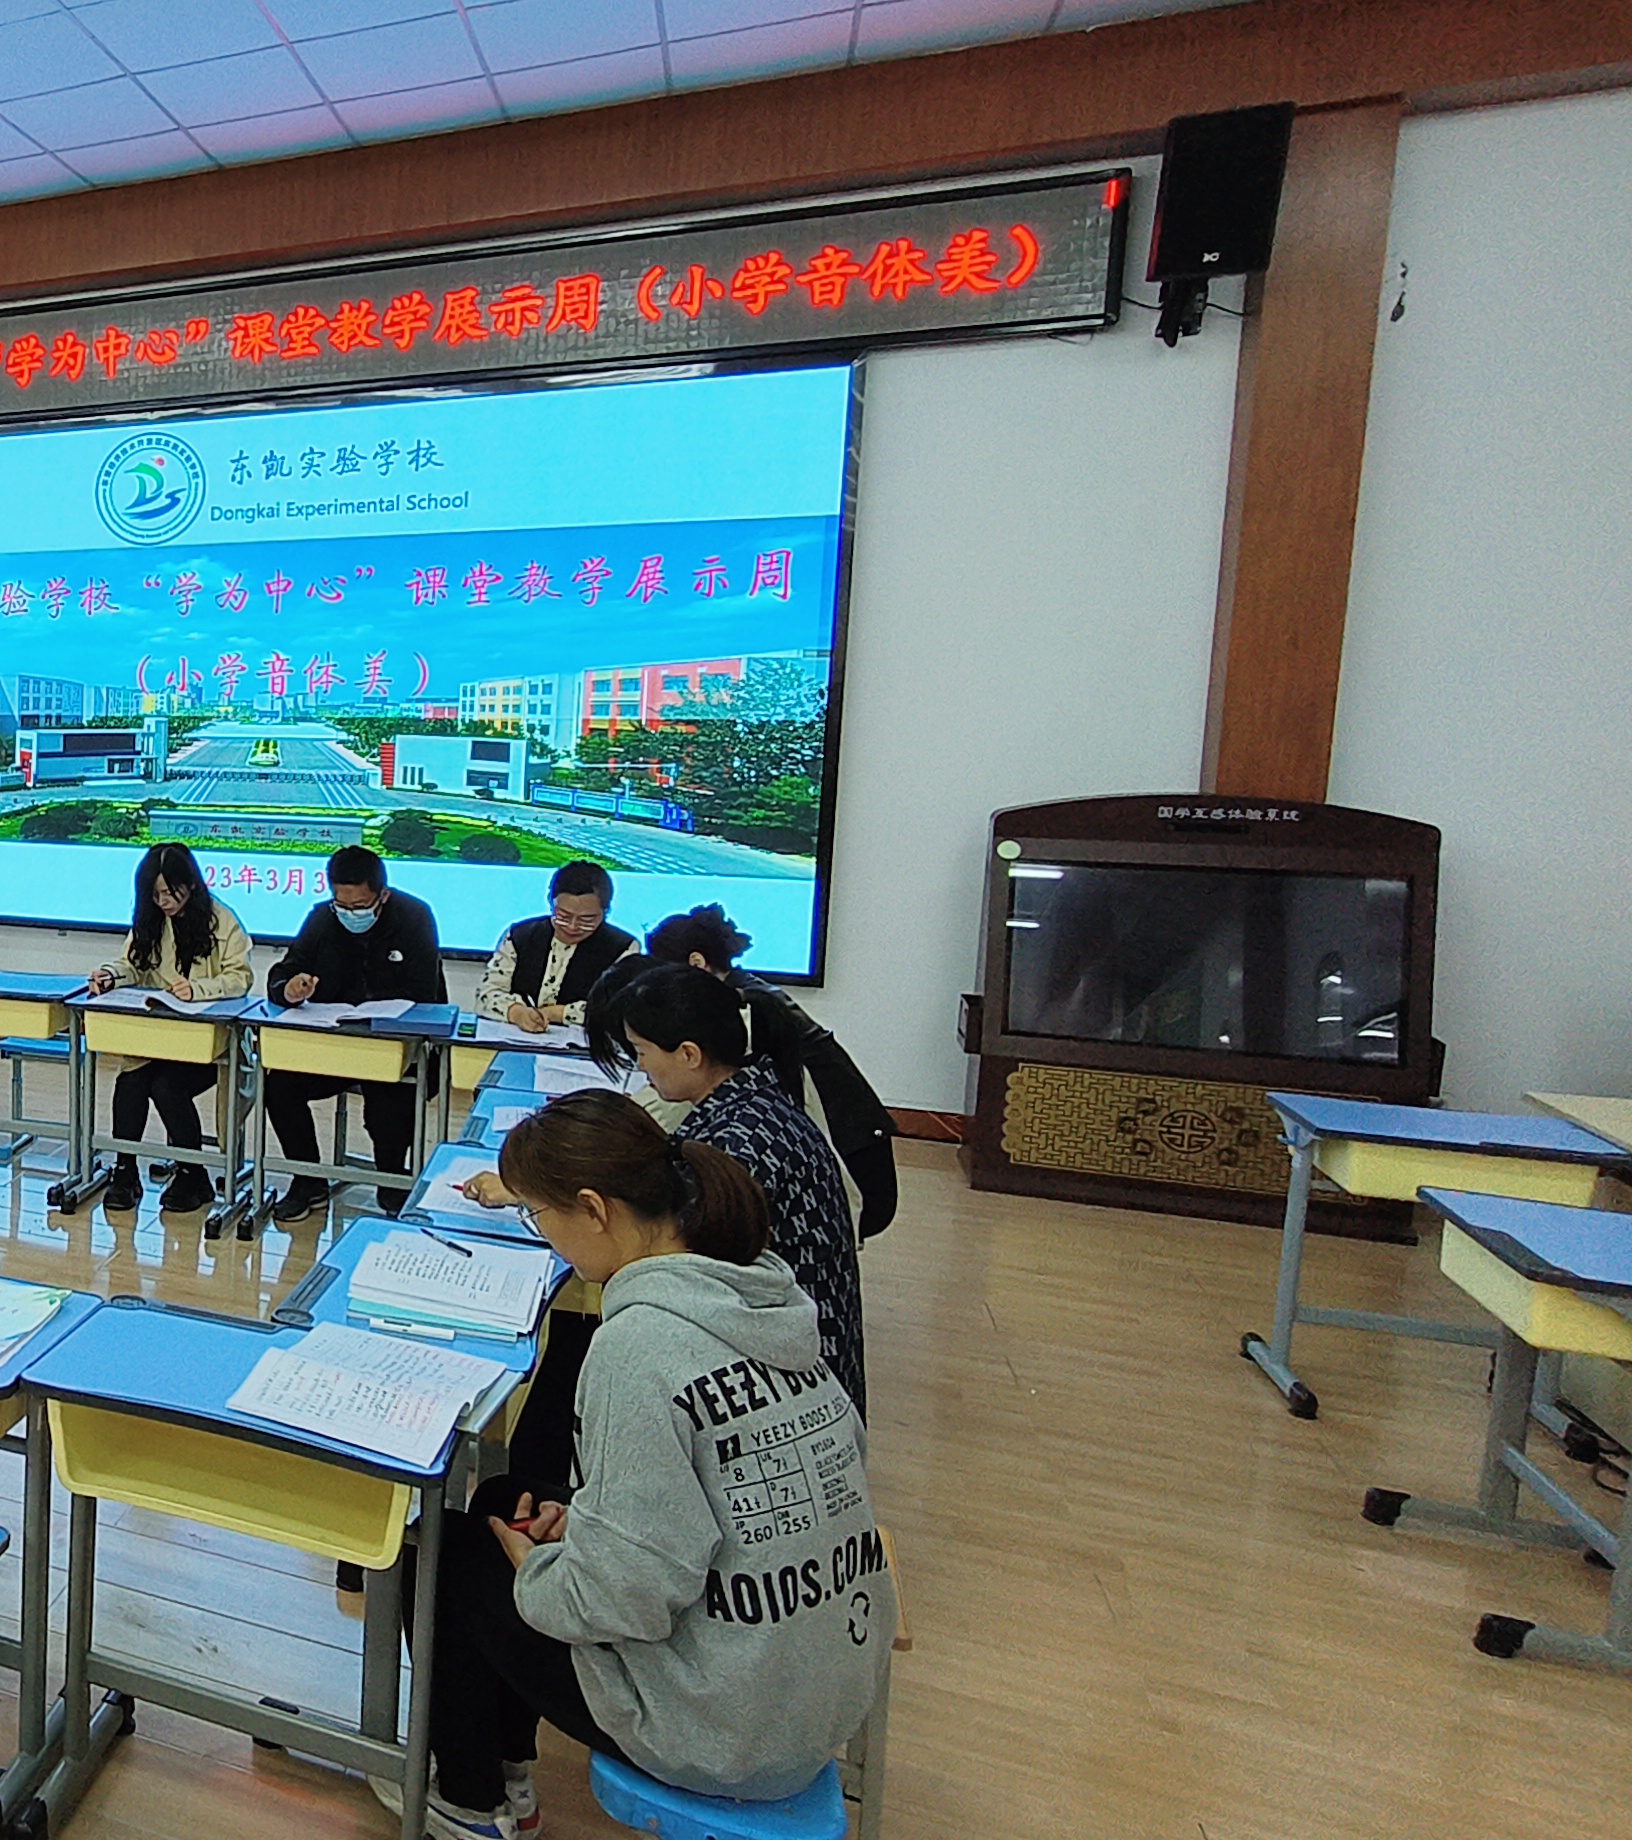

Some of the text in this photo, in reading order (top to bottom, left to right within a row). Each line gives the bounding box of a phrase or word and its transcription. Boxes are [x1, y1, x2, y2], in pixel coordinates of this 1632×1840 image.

[228, 439, 445, 485] 东凯实验学校
[210, 502, 281, 524] Dongkai
[286, 495, 400, 521] Experimental
[406, 490, 469, 512] School
[204, 865, 326, 895] 23年3月3
[672, 1357, 782, 1432] YEEZY
[751, 1419, 798, 1448] YEEZY
[798, 1404, 833, 1431] BOOST
[733, 1467, 745, 1482] 8
[741, 1525, 773, 1544] 260
[782, 1515, 811, 1534] 255
[706, 1528, 887, 1625] AOIOS.COM
